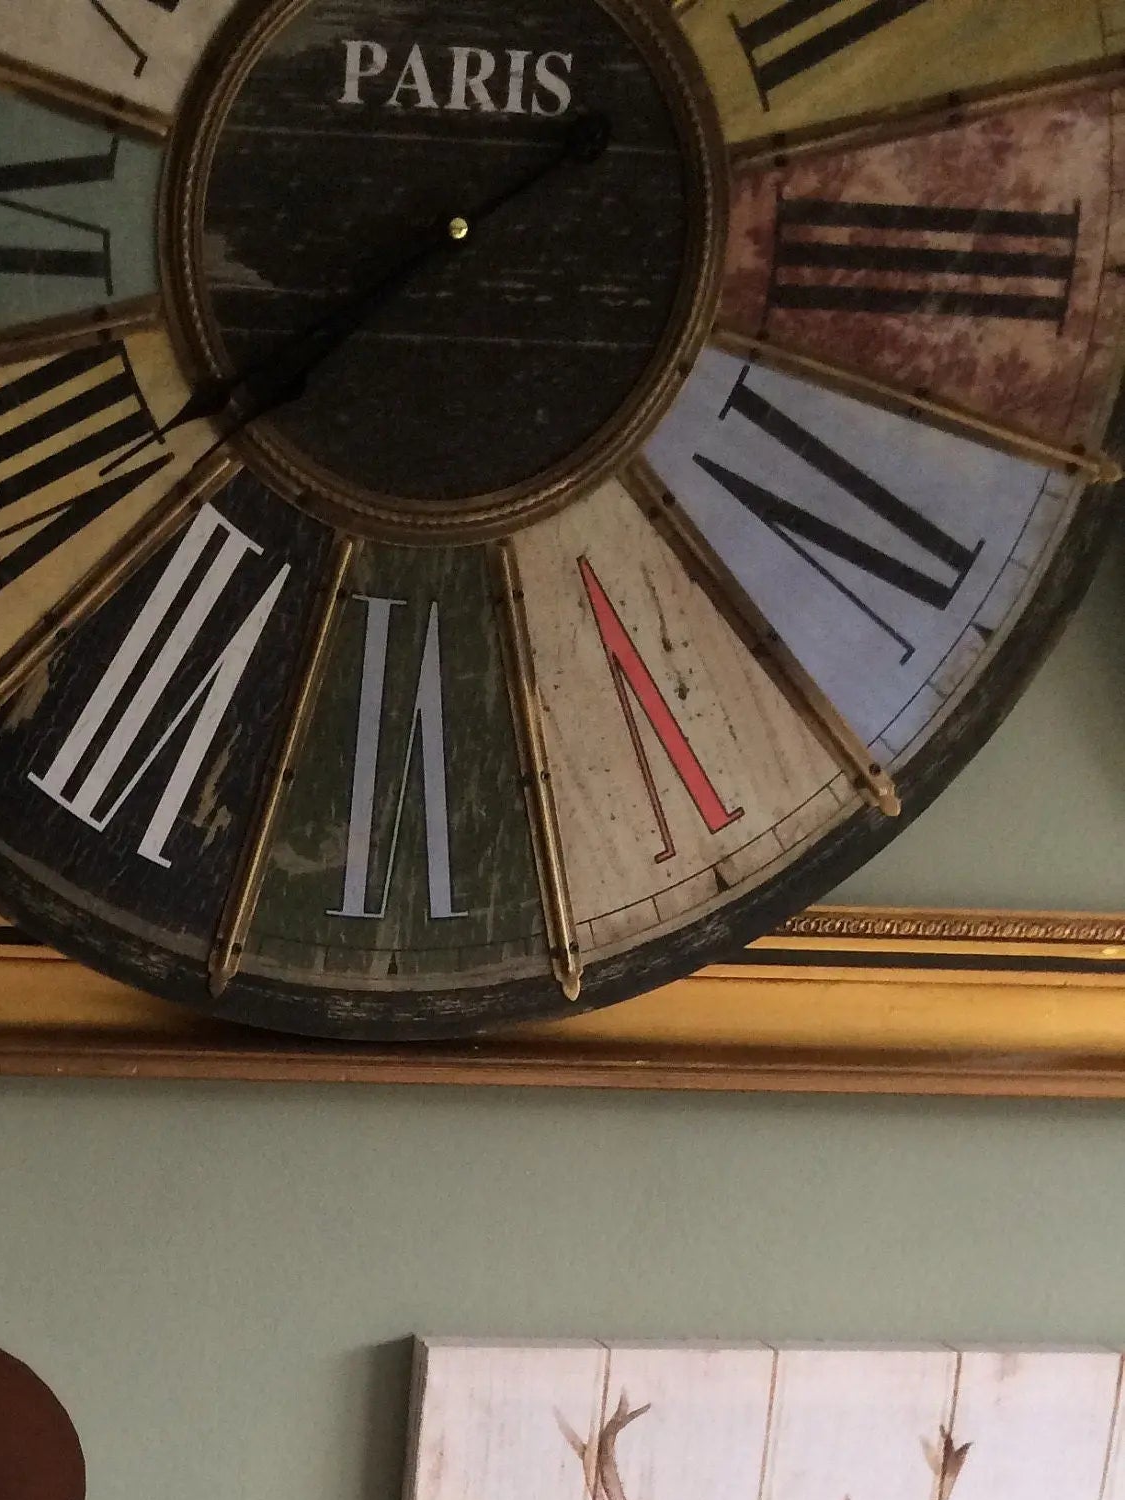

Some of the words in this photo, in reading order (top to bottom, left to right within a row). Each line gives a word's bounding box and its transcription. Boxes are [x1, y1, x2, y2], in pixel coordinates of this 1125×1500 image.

[338, 40, 572, 116] PARIS
[765, 198, 1081, 338] III
[692, 366, 985, 664] IV
[27, 502, 291, 869] VII
[325, 594, 469, 920] VI
[576, 554, 744, 864] V
